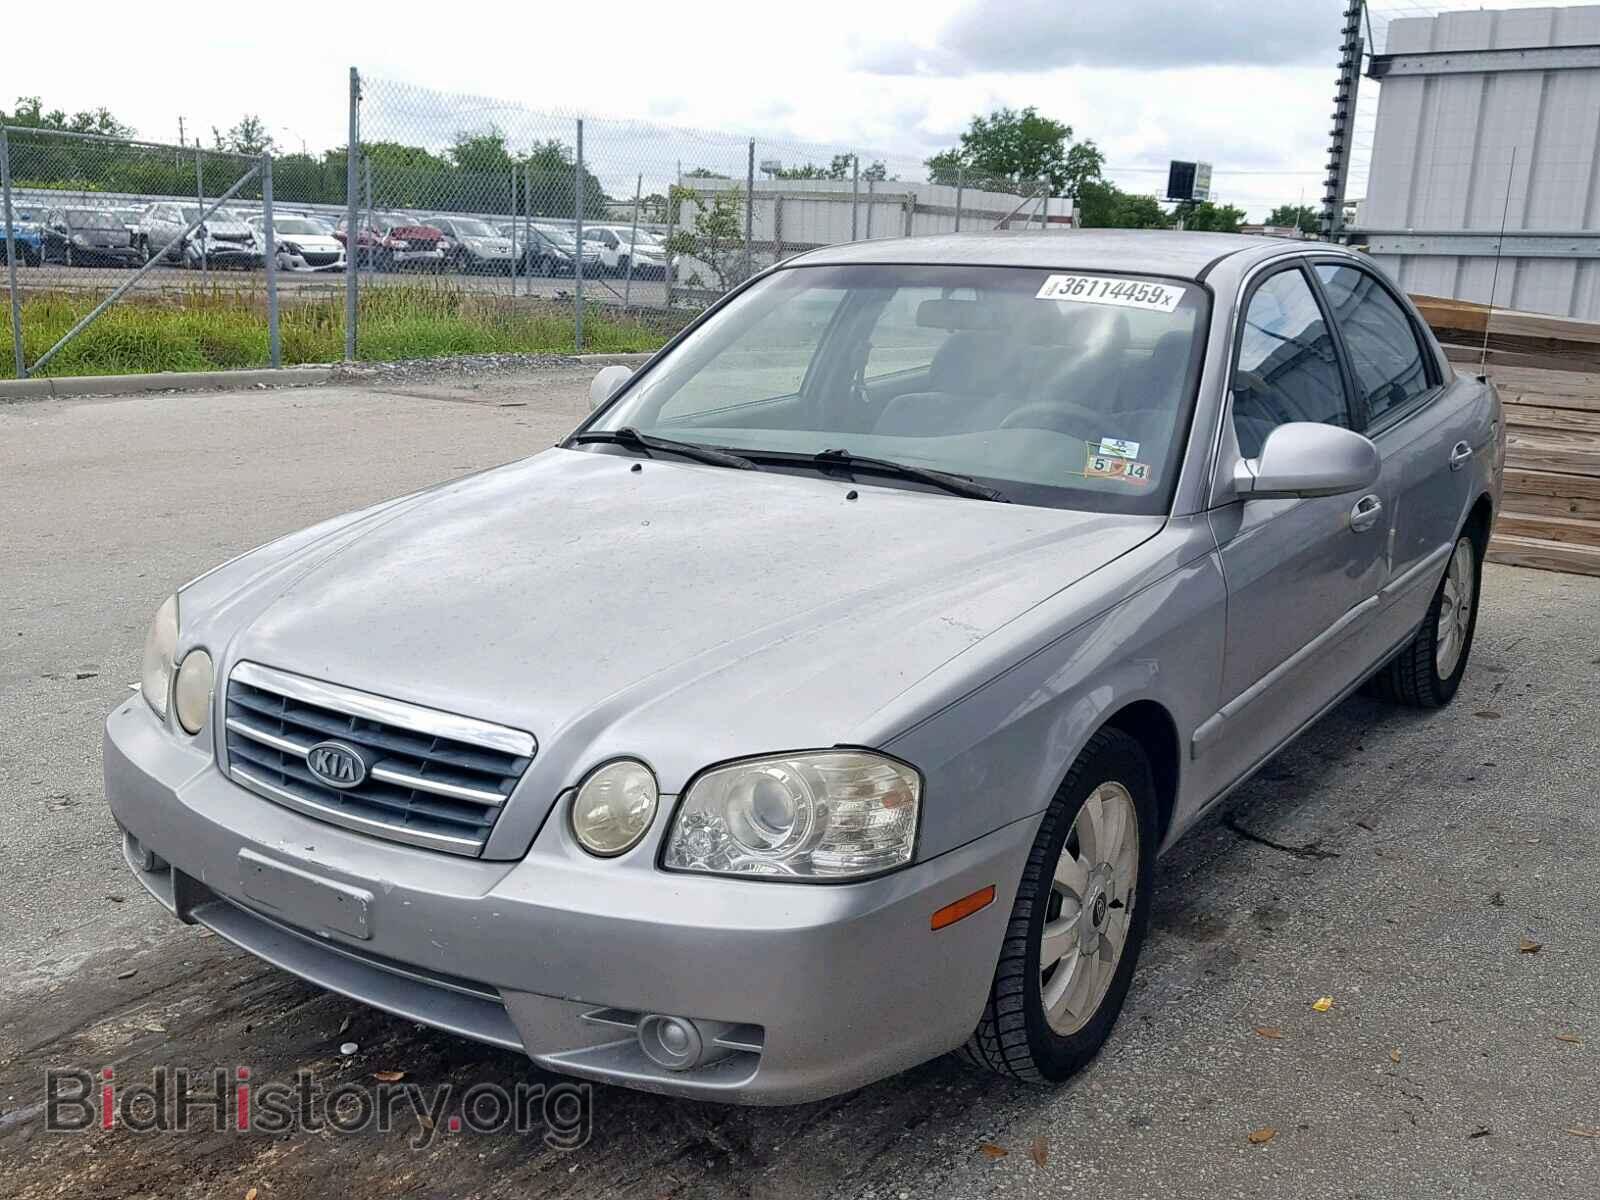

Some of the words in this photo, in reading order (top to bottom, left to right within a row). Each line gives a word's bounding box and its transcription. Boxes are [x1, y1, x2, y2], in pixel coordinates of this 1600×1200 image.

[1094, 458, 1105, 471] 5
[1127, 463, 1145, 478] 14
[316, 749, 355, 781] KIA
